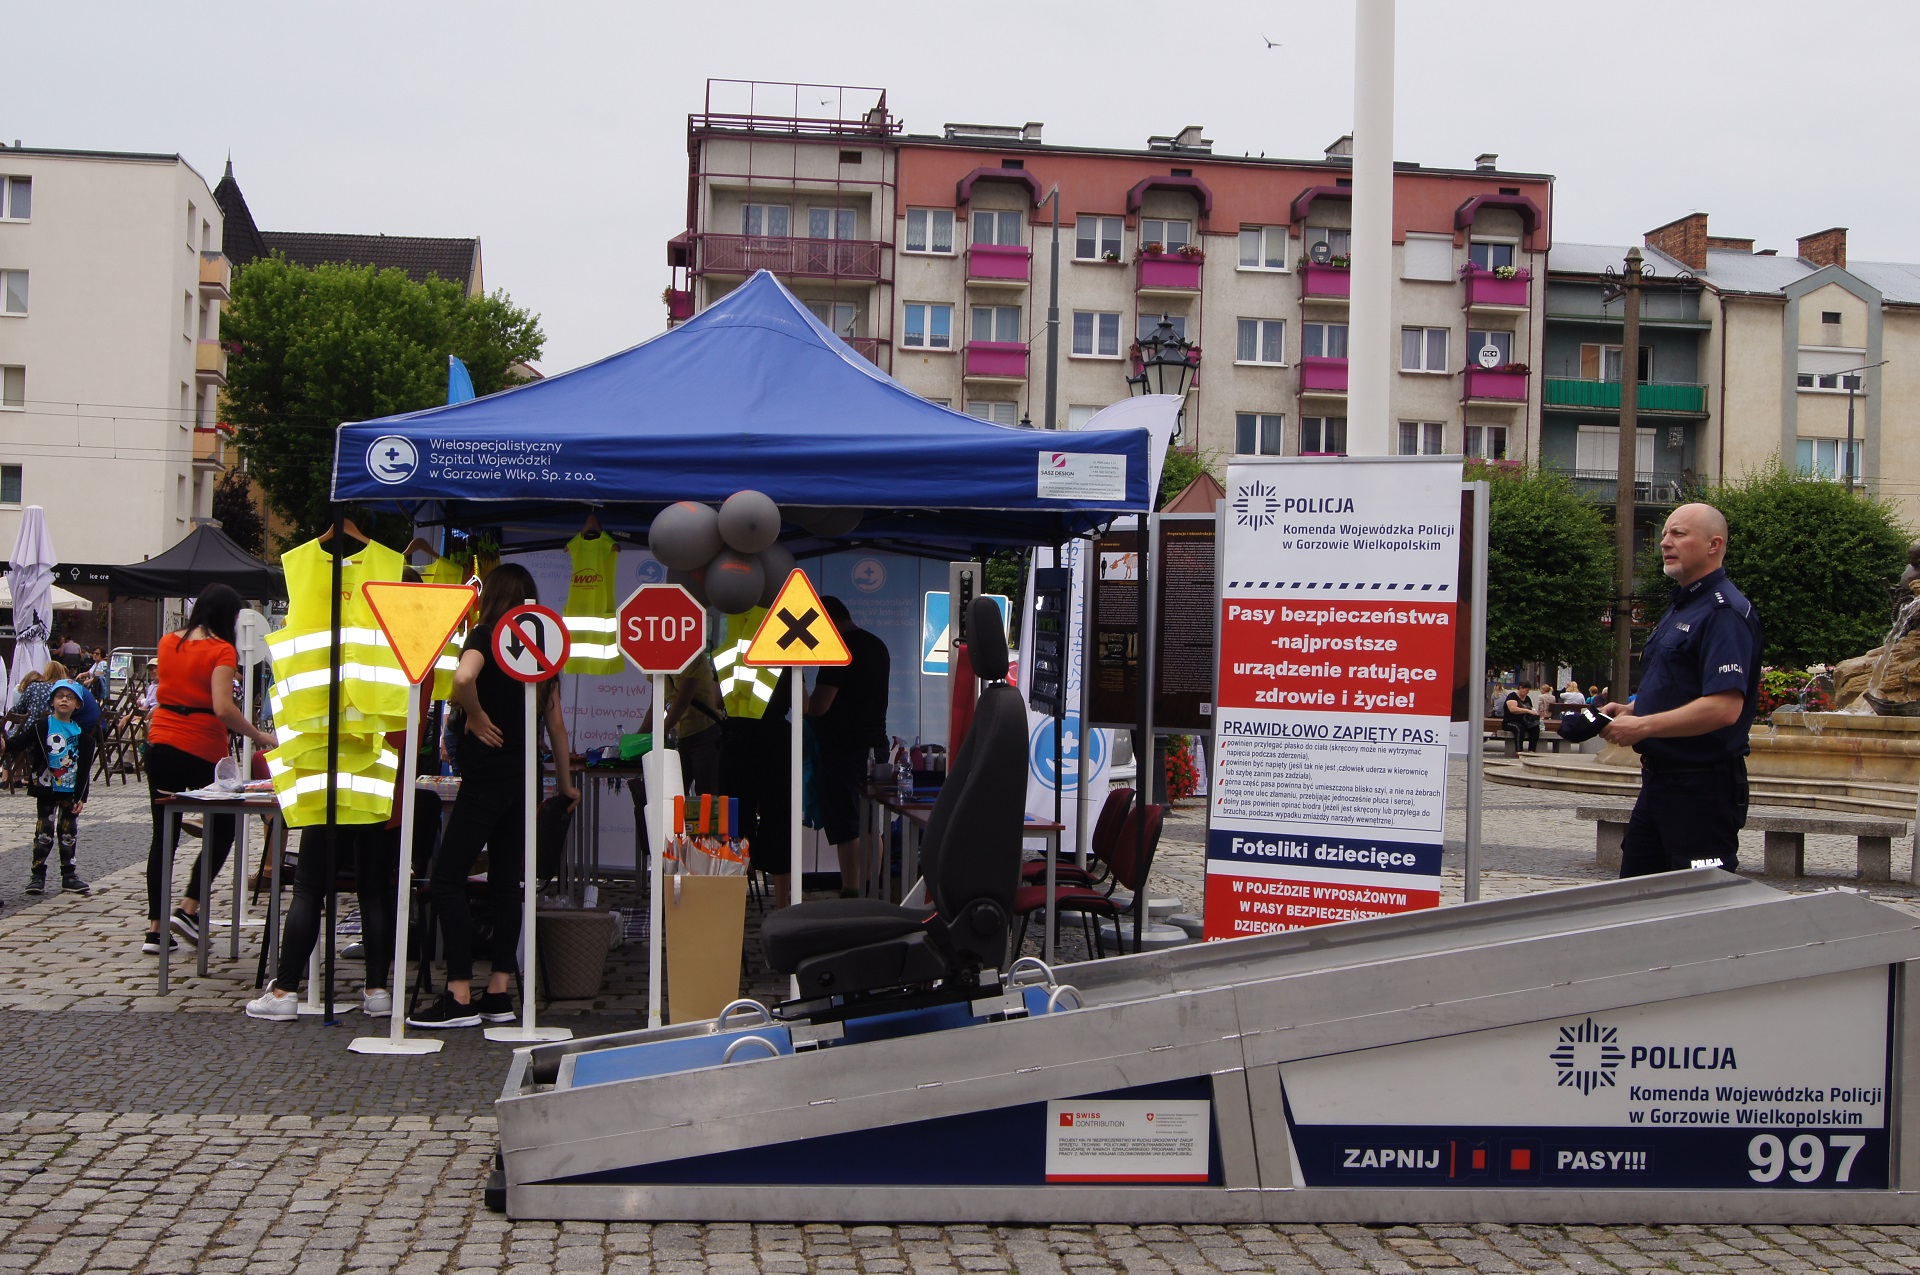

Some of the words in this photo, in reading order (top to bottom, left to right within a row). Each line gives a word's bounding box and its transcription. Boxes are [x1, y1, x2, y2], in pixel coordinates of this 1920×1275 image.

[430, 438, 562, 453] Wielospecjalistyczny
[430, 453, 474, 466] Szpital
[478, 454, 551, 468] Wojewódzki
[430, 470, 439, 478] w
[442, 468, 501, 480] Gorzowie
[505, 470, 539, 483] Wlkp.
[541, 470, 561, 483] Sp.
[564, 473, 572, 481] z
[574, 472, 596, 481] o.o.
[1284, 498, 1354, 514] POLICJA
[1283, 524, 1336, 535] Komenda
[1340, 524, 1414, 537] Wojewódzka
[1418, 524, 1455, 538] Policji
[1296, 539, 1350, 550] Gorzowie
[1353, 539, 1441, 552] Wielkopolskim
[1228, 605, 1276, 624] Pasy
[1281, 606, 1449, 626] bezpieczeństwa
[628, 616, 696, 642] STOP
[1272, 634, 1397, 653] -najprostsze
[1233, 660, 1342, 679] urządzenie
[1348, 664, 1437, 684] ratujące
[1255, 688, 1336, 704] zdrowie
[1342, 690, 1347, 705] i
[1354, 690, 1415, 710] życie!
[1224, 721, 1328, 738] PRAWIDŁOWO
[1333, 726, 1398, 744] ZAPIĘTY
[1402, 728, 1439, 743] PAS:
[1227, 740, 1252, 749] powinien
[1254, 741, 1282, 751] przylegać
[1284, 742, 1303, 751] płasko
[1314, 743, 1328, 751] ciała
[1329, 744, 1358, 754] (skręcony
[1360, 745, 1376, 753] może
[1378, 746, 1386, 754] nie
[1388, 746, 1422, 756] wytrzymać
[1227, 750, 1250, 758] napięcia
[1252, 751, 1276, 759] podczas
[1226, 760, 1251, 768] powinien
[1253, 760, 1264, 769] być
[1265, 761, 1287, 770] napięty
[1304, 762, 1313, 770] tak
[1324, 763, 1335, 772] jest
[1366, 766, 1386, 774] uderza
[1394, 767, 1428, 777] kierownicę
[1226, 768, 1234, 776] lub
[1236, 769, 1252, 778] szybę
[1273, 772, 1284, 780] pas
[1242, 779, 1259, 788] część
[1261, 781, 1275, 789] pasa
[1276, 781, 1301, 790] powinna
[1303, 782, 1314, 791] być
[1315, 783, 1353, 792] umieszczona
[1355, 785, 1373, 793] blisko
[1395, 787, 1404, 795] nie
[1415, 787, 1440, 797] żebrach
[1256, 789, 1268, 797] ulec
[1299, 792, 1331, 802] przebijając
[1331, 794, 1371, 803] jednocześnie
[1372, 796, 1389, 805] płuca
[1224, 798, 1239, 806] dolny
[1252, 799, 1280, 808] powinien
[1281, 801, 1301, 810] opinać
[1302, 802, 1320, 810] biodra
[1340, 804, 1352, 813] jest
[1354, 805, 1381, 815] skręcony
[1382, 805, 1392, 814] lub
[1393, 807, 1420, 817] przylega
[1422, 809, 1430, 817] do
[1249, 810, 1273, 818] podczas
[1275, 811, 1301, 820] wypadku
[1302, 813, 1329, 822] zmiażdży
[1331, 814, 1354, 823] narządy
[1232, 837, 1309, 858] Foteliki
[1314, 844, 1416, 868] dziecięce
[1691, 858, 1723, 869] POLICJA
[1232, 881, 1243, 892] W
[1246, 882, 1310, 898] POJEŹDZIE
[1313, 886, 1406, 906] WYPOSAŻONYM
[1240, 901, 1250, 912] W
[1253, 902, 1283, 914] PASY
[1234, 920, 1286, 932] DZIECKO
[1631, 1046, 1737, 1070] POLICJA
[1630, 1086, 1709, 1101] Komenda
[1716, 1086, 1824, 1105] Wojewódzka
[1830, 1087, 1882, 1106] Policji
[1629, 1112, 1644, 1123] w
[1650, 1108, 1730, 1124] Gorzowie
[1736, 1109, 1863, 1127] Wielkopolskim
[1343, 1148, 1440, 1169] ZAPNIJ
[1557, 1151, 1646, 1170] PASY!!!
[1748, 1134, 1866, 1182] 997
